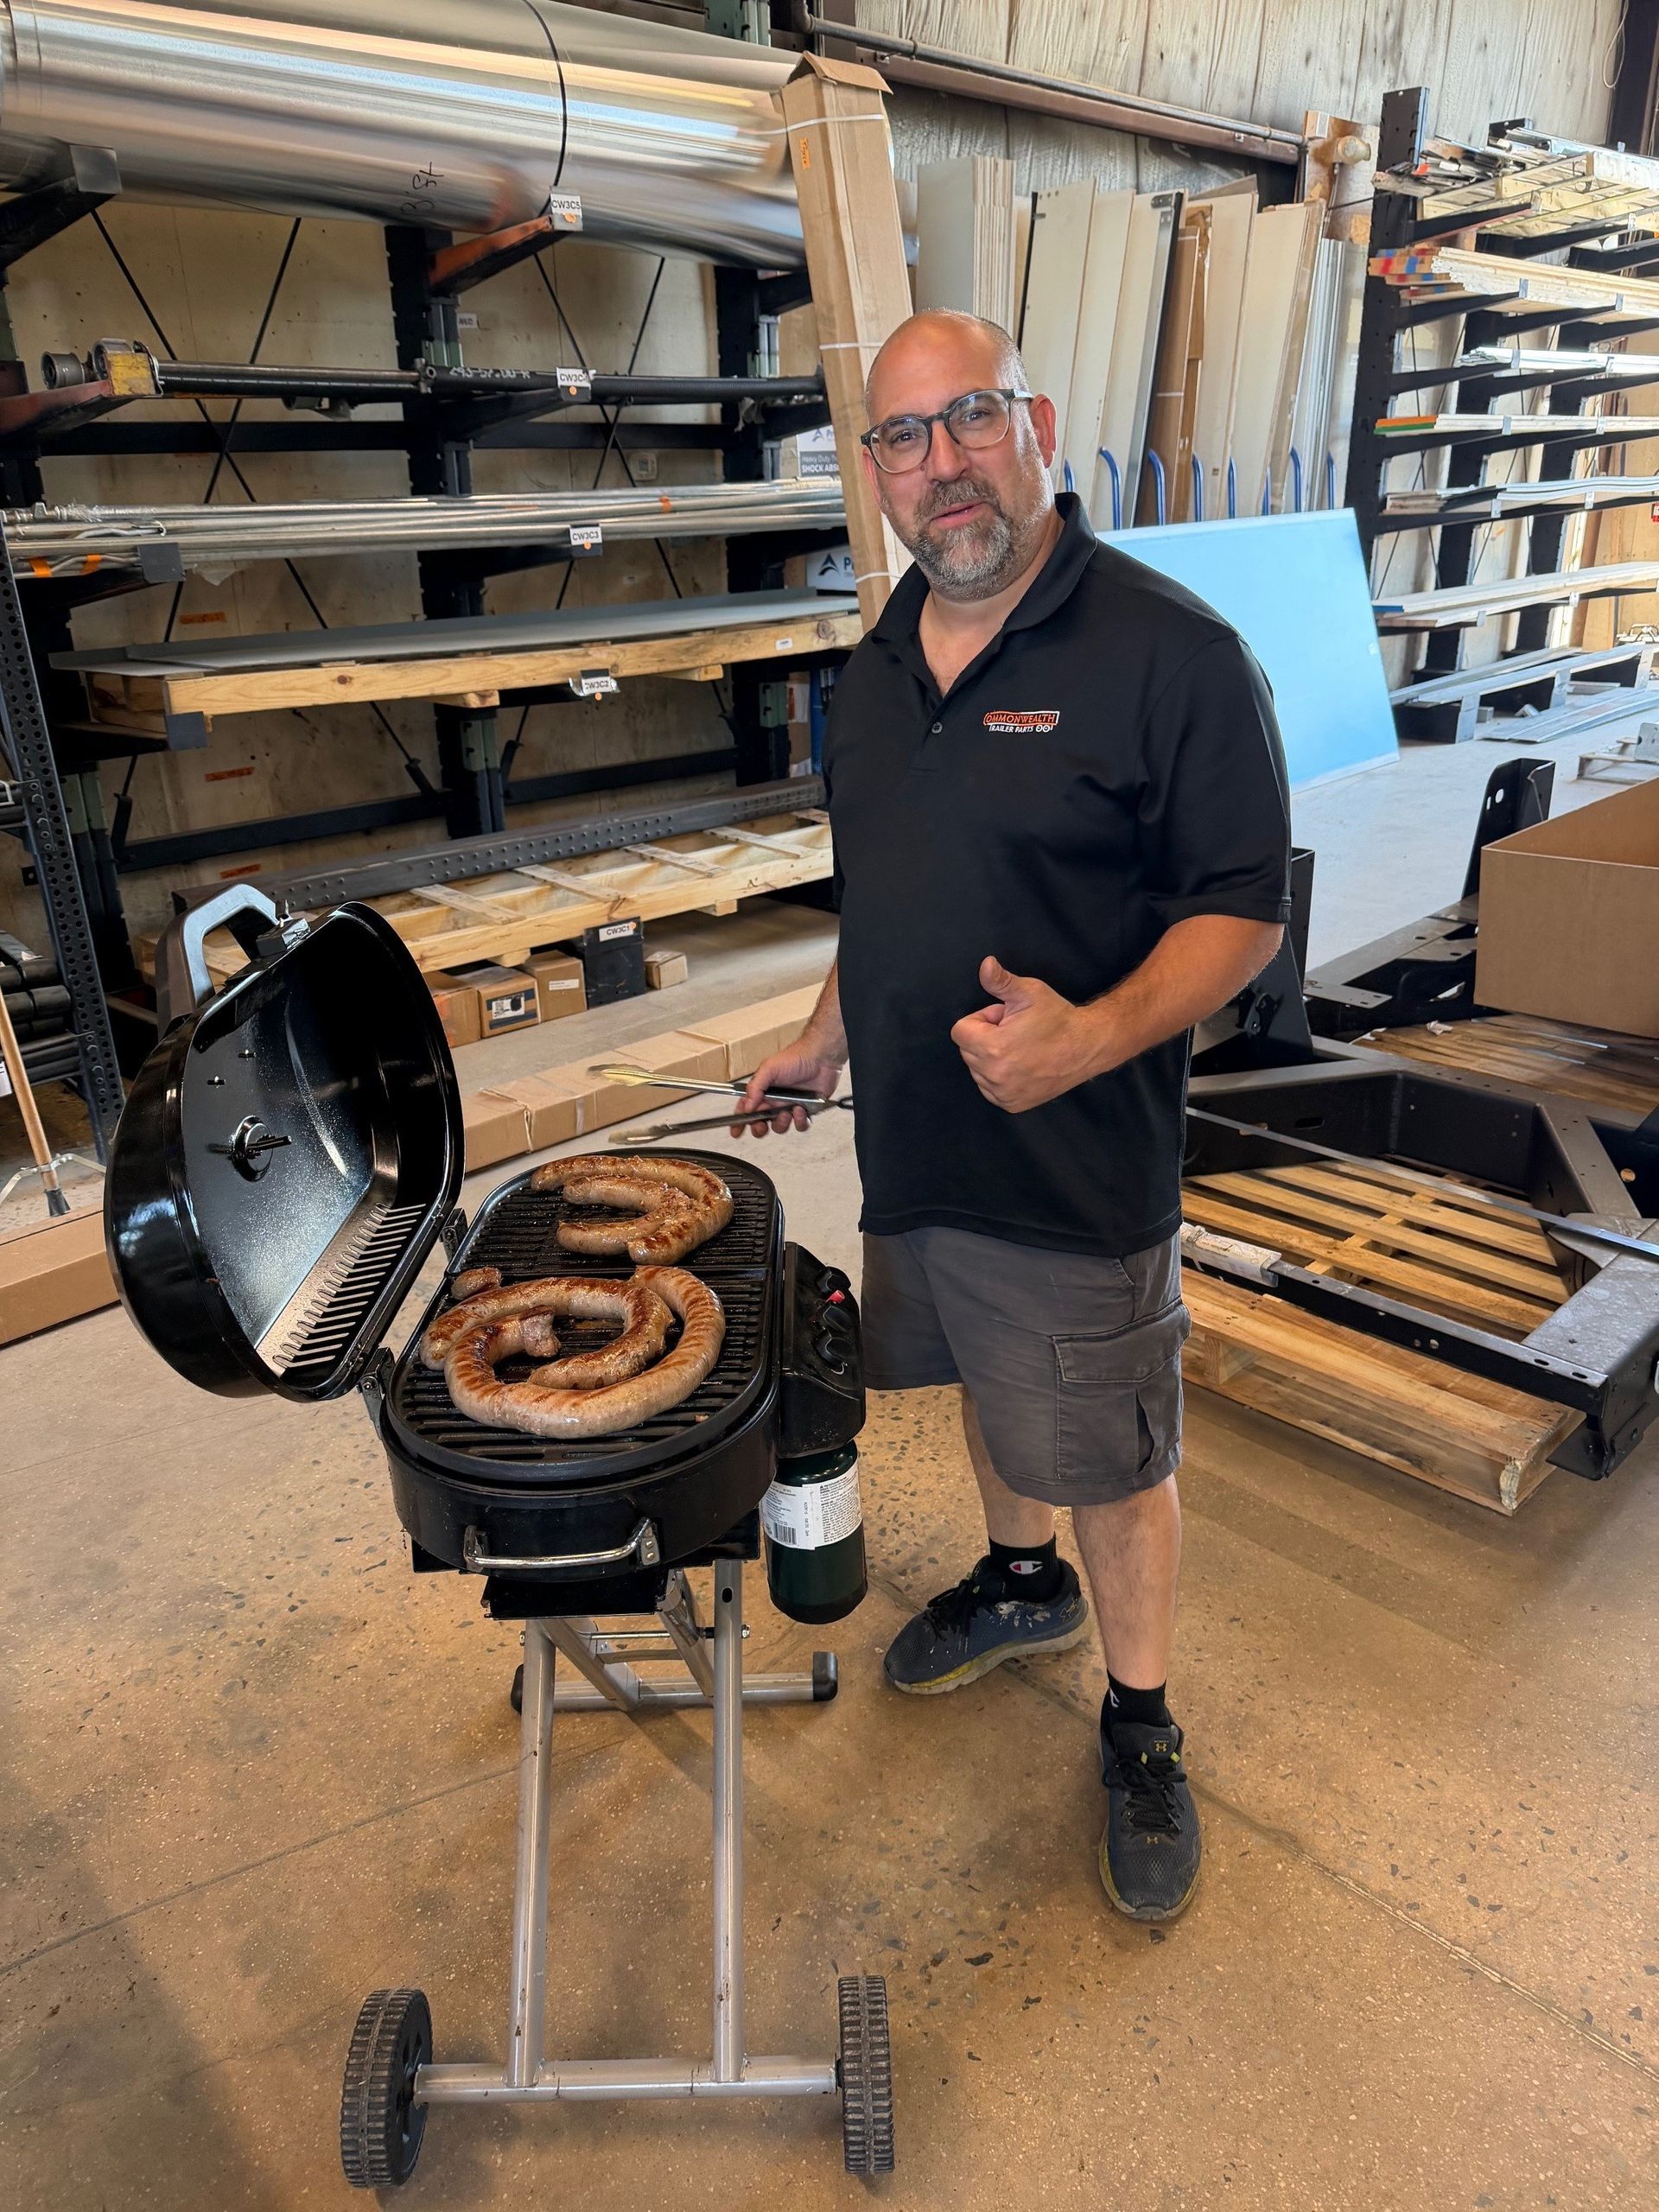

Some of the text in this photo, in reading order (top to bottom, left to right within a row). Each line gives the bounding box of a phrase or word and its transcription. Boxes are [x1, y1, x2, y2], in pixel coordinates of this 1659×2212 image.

[551, 200, 581, 210] CW3C5
[802, 464, 823, 474] SHOCK
[572, 531, 600, 541] CW3C3
[988, 725, 1034, 734] TRAILER PARTS
[606, 925, 630, 936] CW3C1
